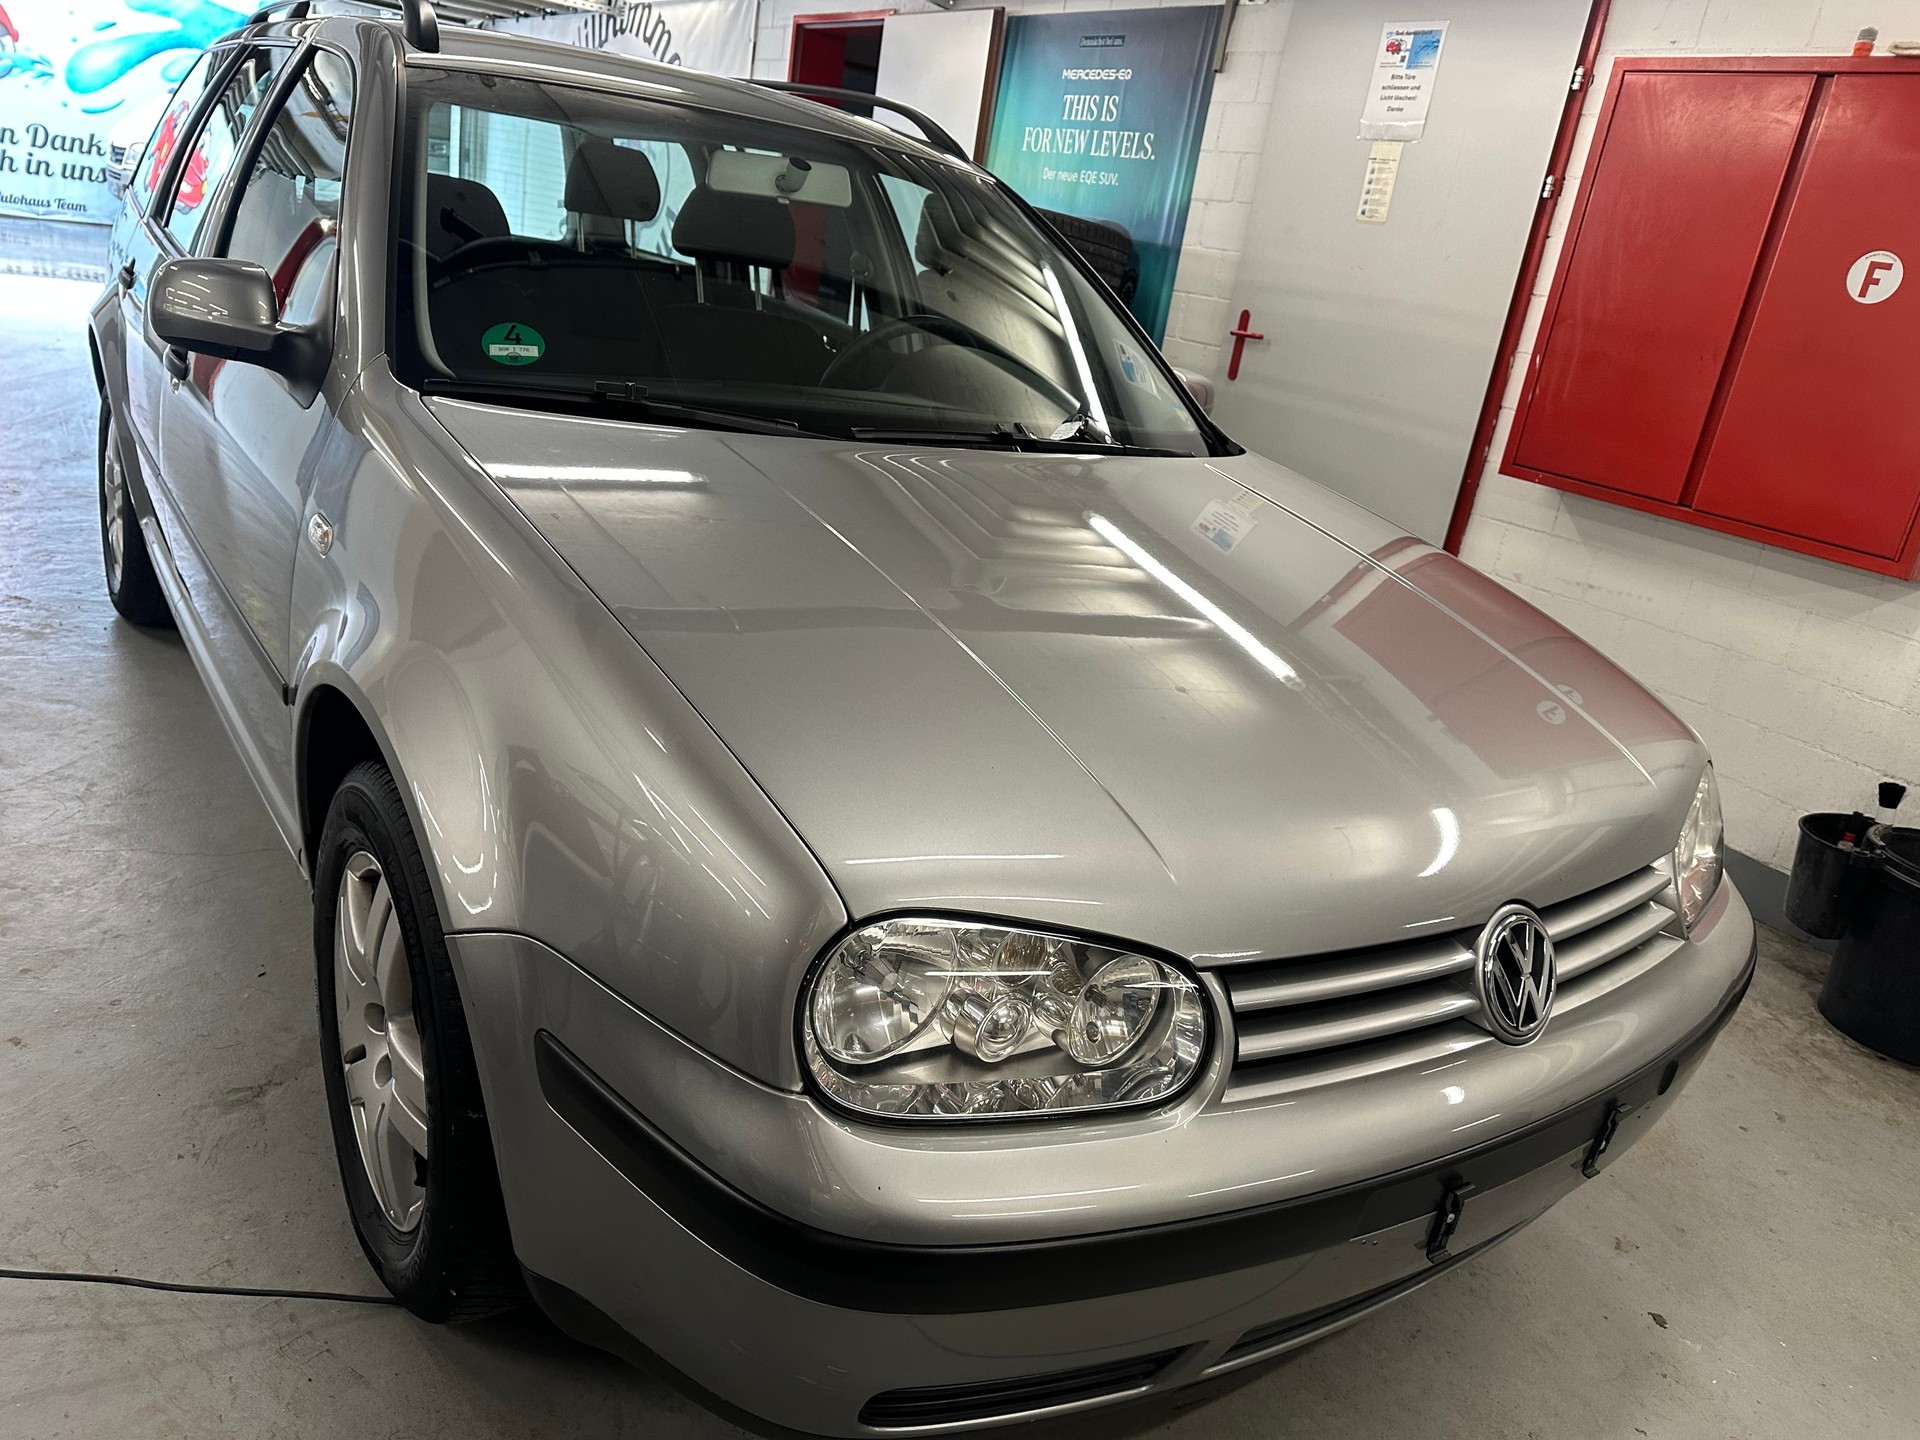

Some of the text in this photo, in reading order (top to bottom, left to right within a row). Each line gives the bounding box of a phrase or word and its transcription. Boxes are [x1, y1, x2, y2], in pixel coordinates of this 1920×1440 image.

[1062, 69, 1132, 80] MERCEDES-EQ
[1062, 94, 1119, 122] THIS IS
[25, 123, 107, 157] Dank
[1022, 127, 1155, 160] FOR NEW LEVELS.
[25, 152, 54, 177] in
[1042, 167, 1119, 186] Der neue EQE SUV.
[54, 198, 87, 212] Team
[1858, 261, 1894, 298] F
[504, 324, 522, 344] 4
